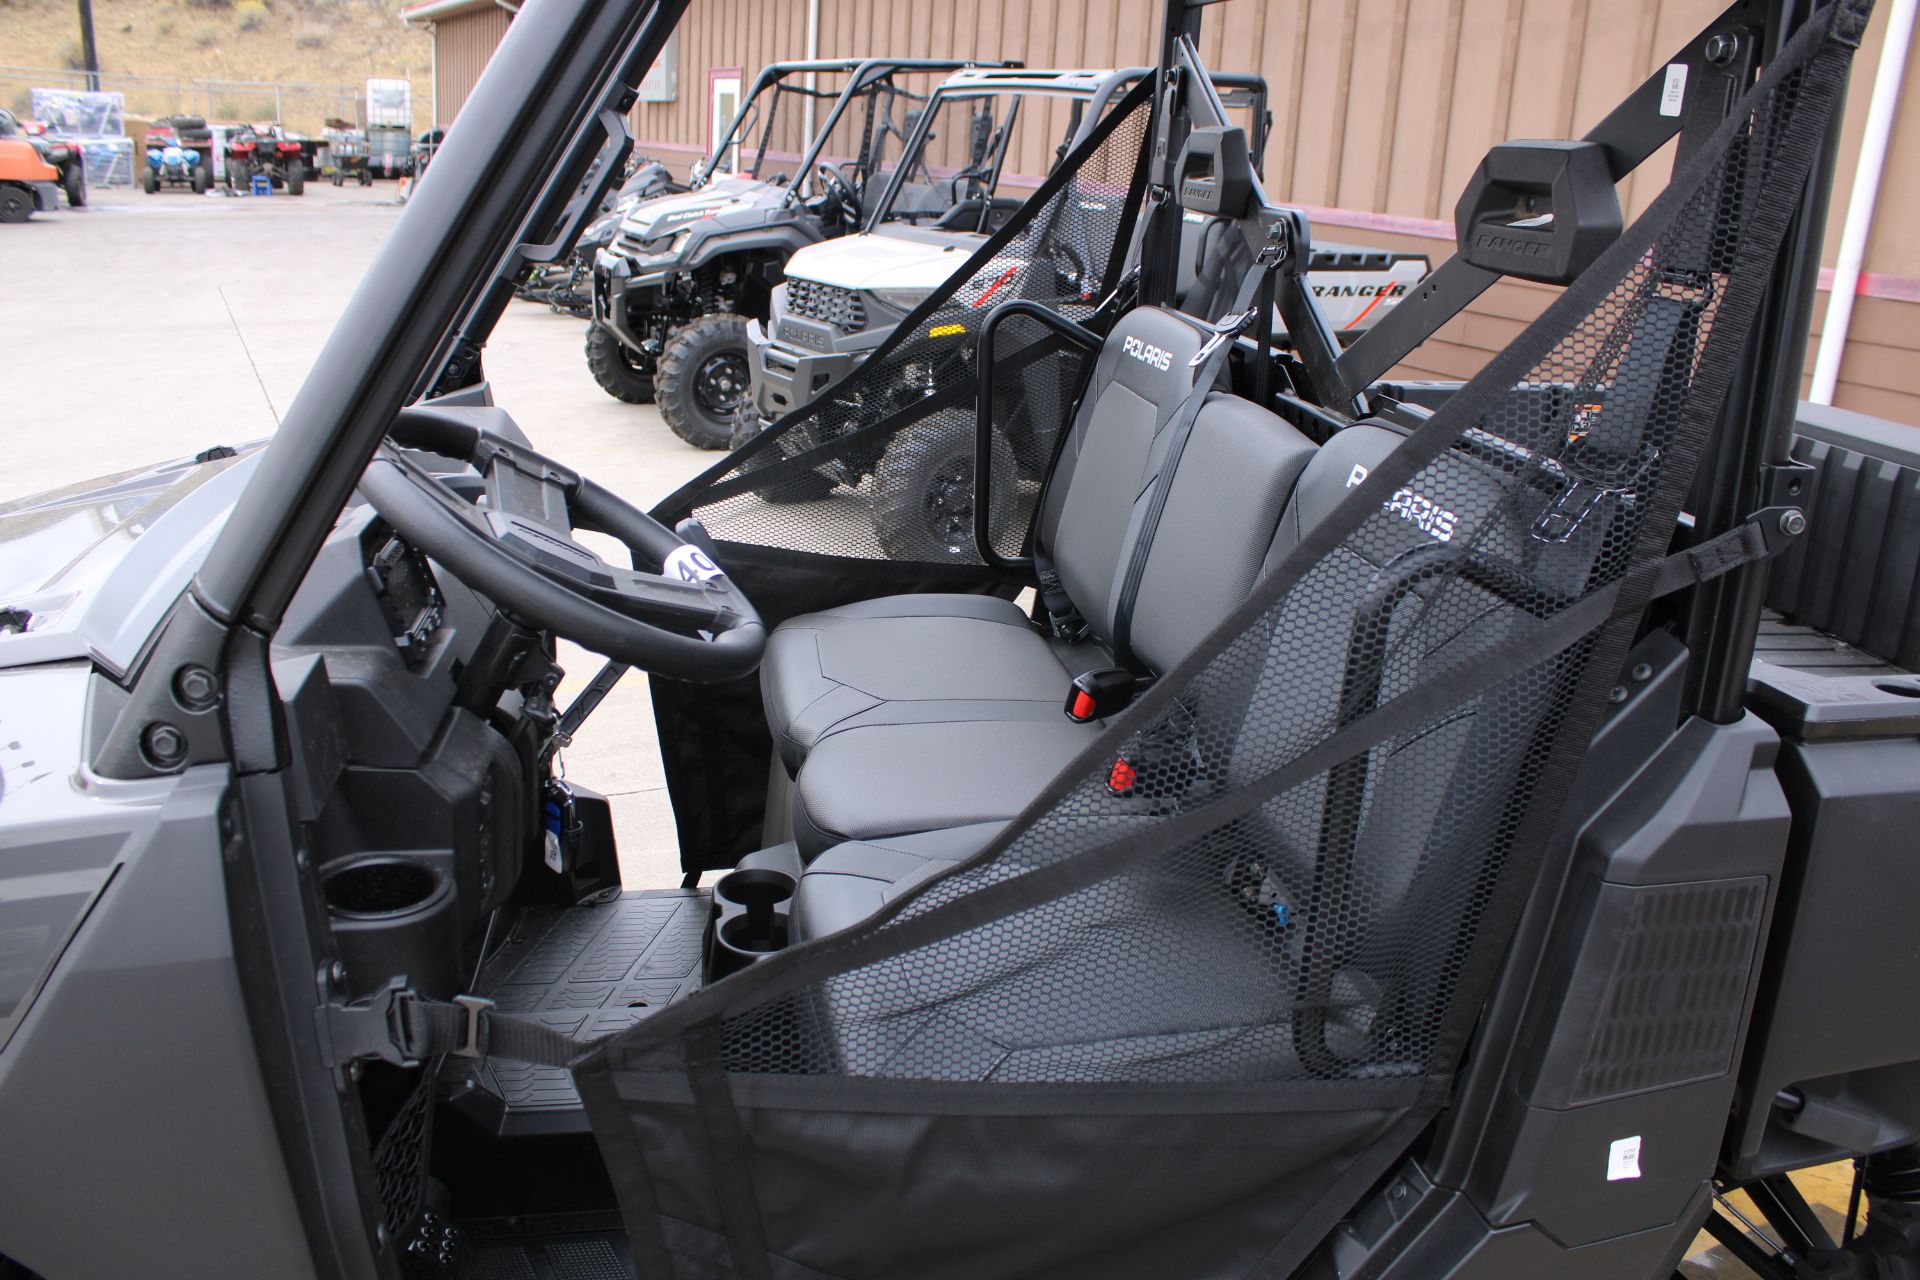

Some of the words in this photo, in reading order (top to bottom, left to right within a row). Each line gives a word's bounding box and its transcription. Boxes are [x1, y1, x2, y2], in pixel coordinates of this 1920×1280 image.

[1476, 234, 1553, 257] RANGER
[1311, 285, 1407, 297] RANGER
[1123, 335, 1173, 371] POLARIS
[1345, 463, 1458, 541] PARIS
